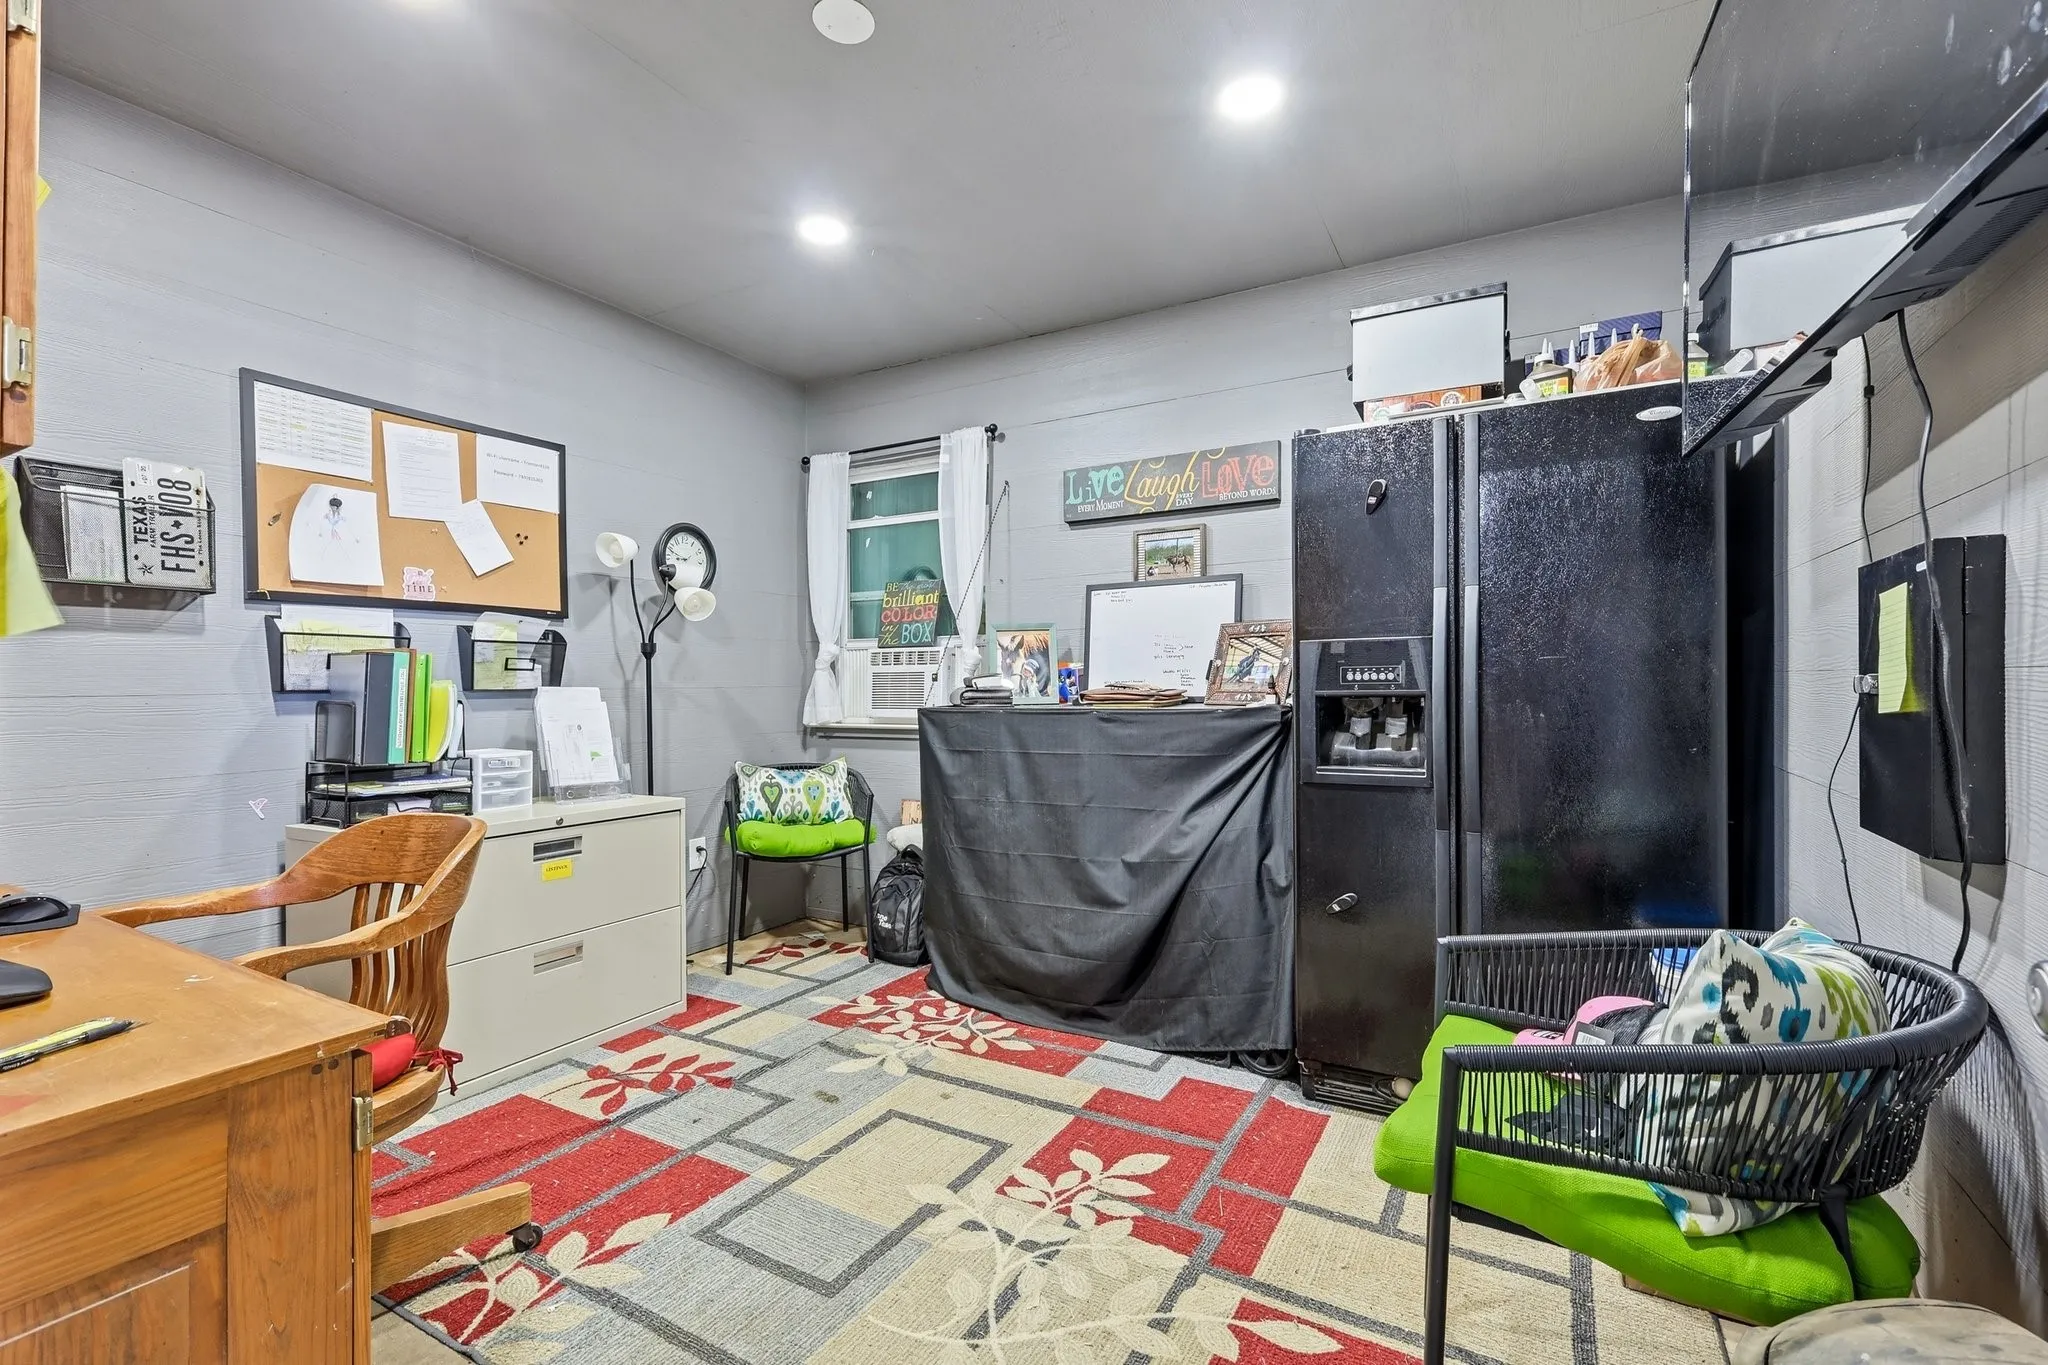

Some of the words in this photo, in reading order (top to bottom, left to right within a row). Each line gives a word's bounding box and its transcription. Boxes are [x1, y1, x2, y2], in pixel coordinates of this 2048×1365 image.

[1124, 450, 1200, 512] Laugh
[157, 478, 194, 518] V08
[1176, 498, 1194, 507] DAY
[1219, 490, 1249, 501] BEYOND
[1249, 486, 1277, 497] WORDS
[131, 496, 148, 544] TEXAS
[159, 532, 196, 573] FHS
[886, 582, 899, 592] BE
[882, 590, 939, 608] brilliant
[881, 604, 935, 622] COLOR
[901, 622, 933, 644] BOX
